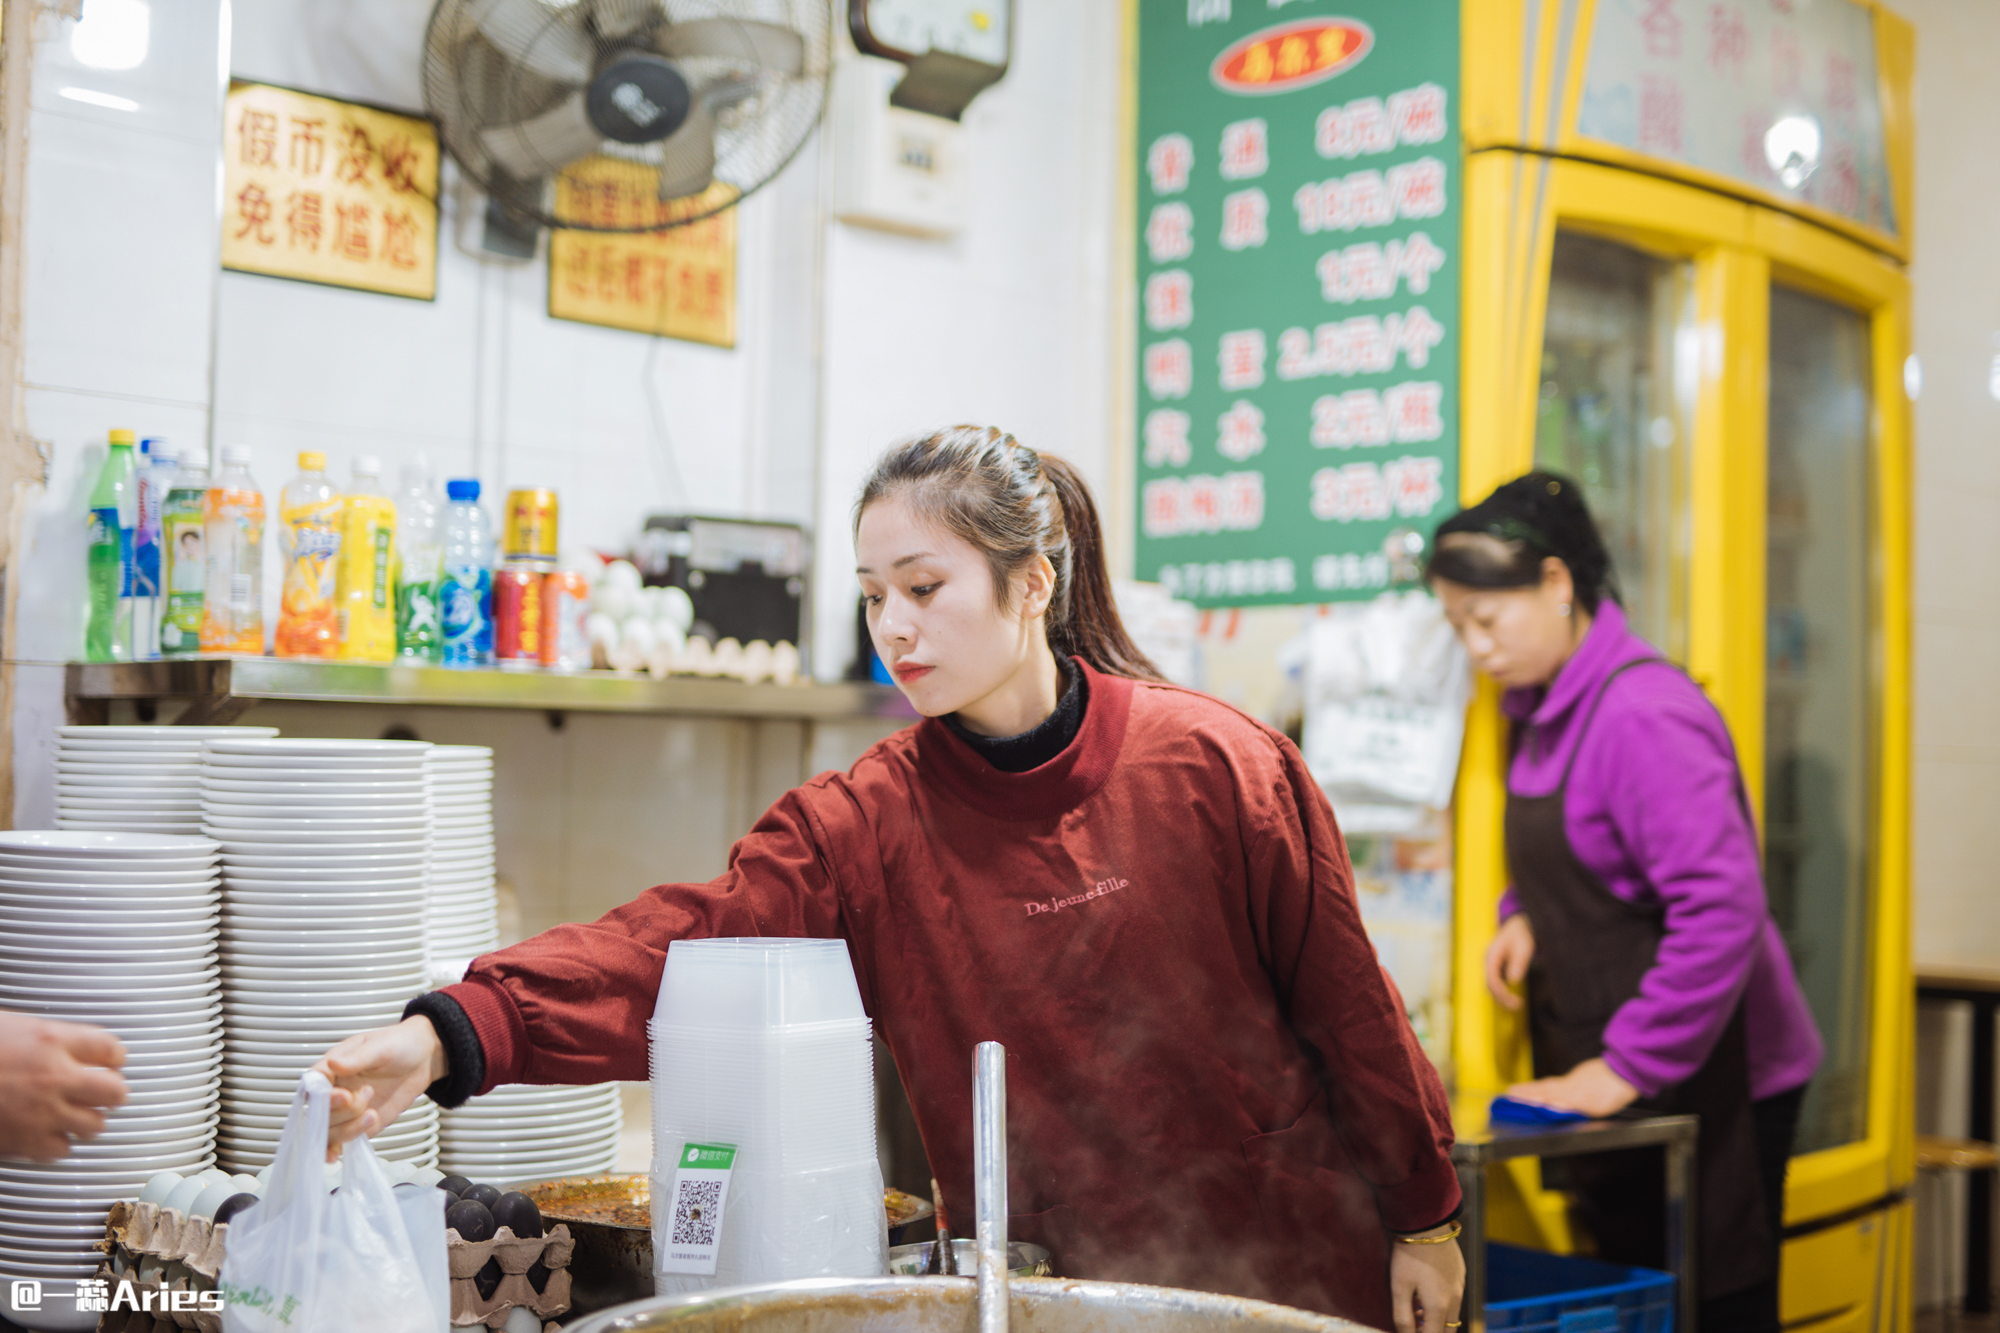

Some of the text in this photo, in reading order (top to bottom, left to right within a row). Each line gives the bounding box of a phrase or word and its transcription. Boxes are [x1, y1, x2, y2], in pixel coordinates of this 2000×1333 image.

[236, 106, 420, 194] 假币没收
[234, 183, 420, 269] 免得尴尬
[699, 1149, 730, 1162] 微信支付
